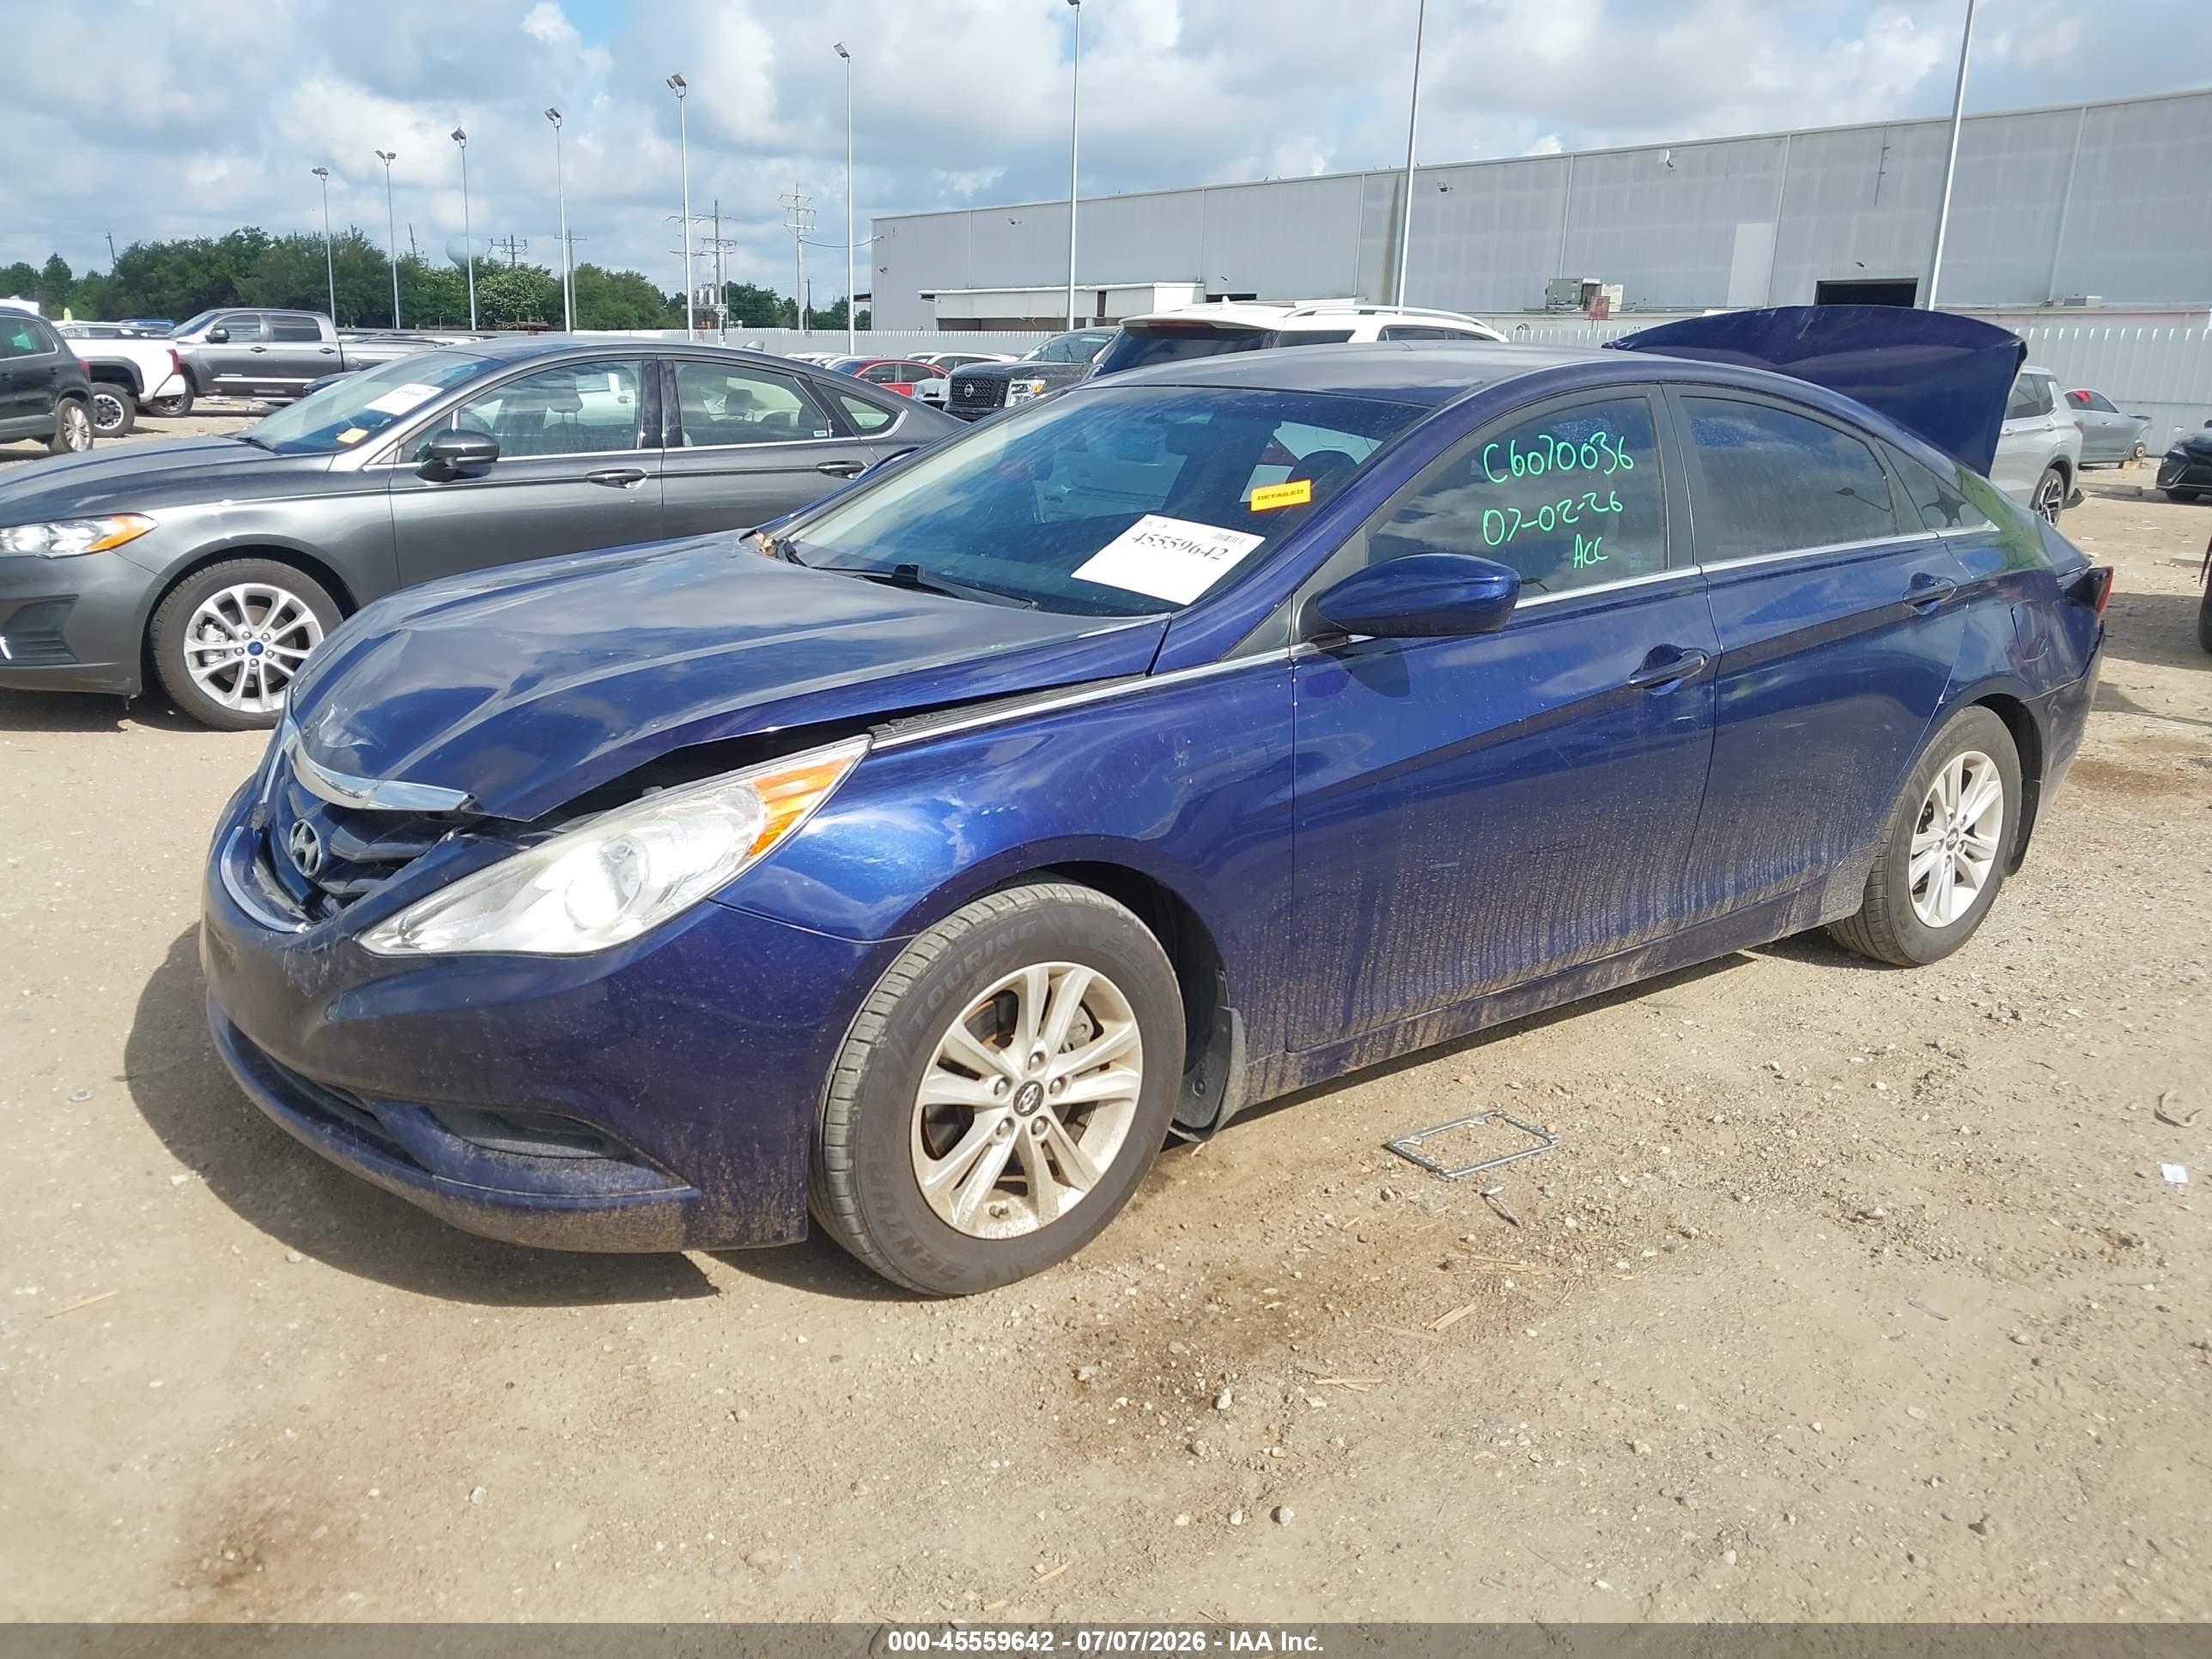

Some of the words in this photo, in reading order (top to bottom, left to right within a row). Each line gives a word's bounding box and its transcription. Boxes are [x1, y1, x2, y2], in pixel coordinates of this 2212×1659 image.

[1257, 489, 1304, 501] DETAILED
[1482, 490, 1624, 546] 07-02-26
[1132, 532, 1229, 561] 45559642
[908, 920, 1038, 1027] TOURING
